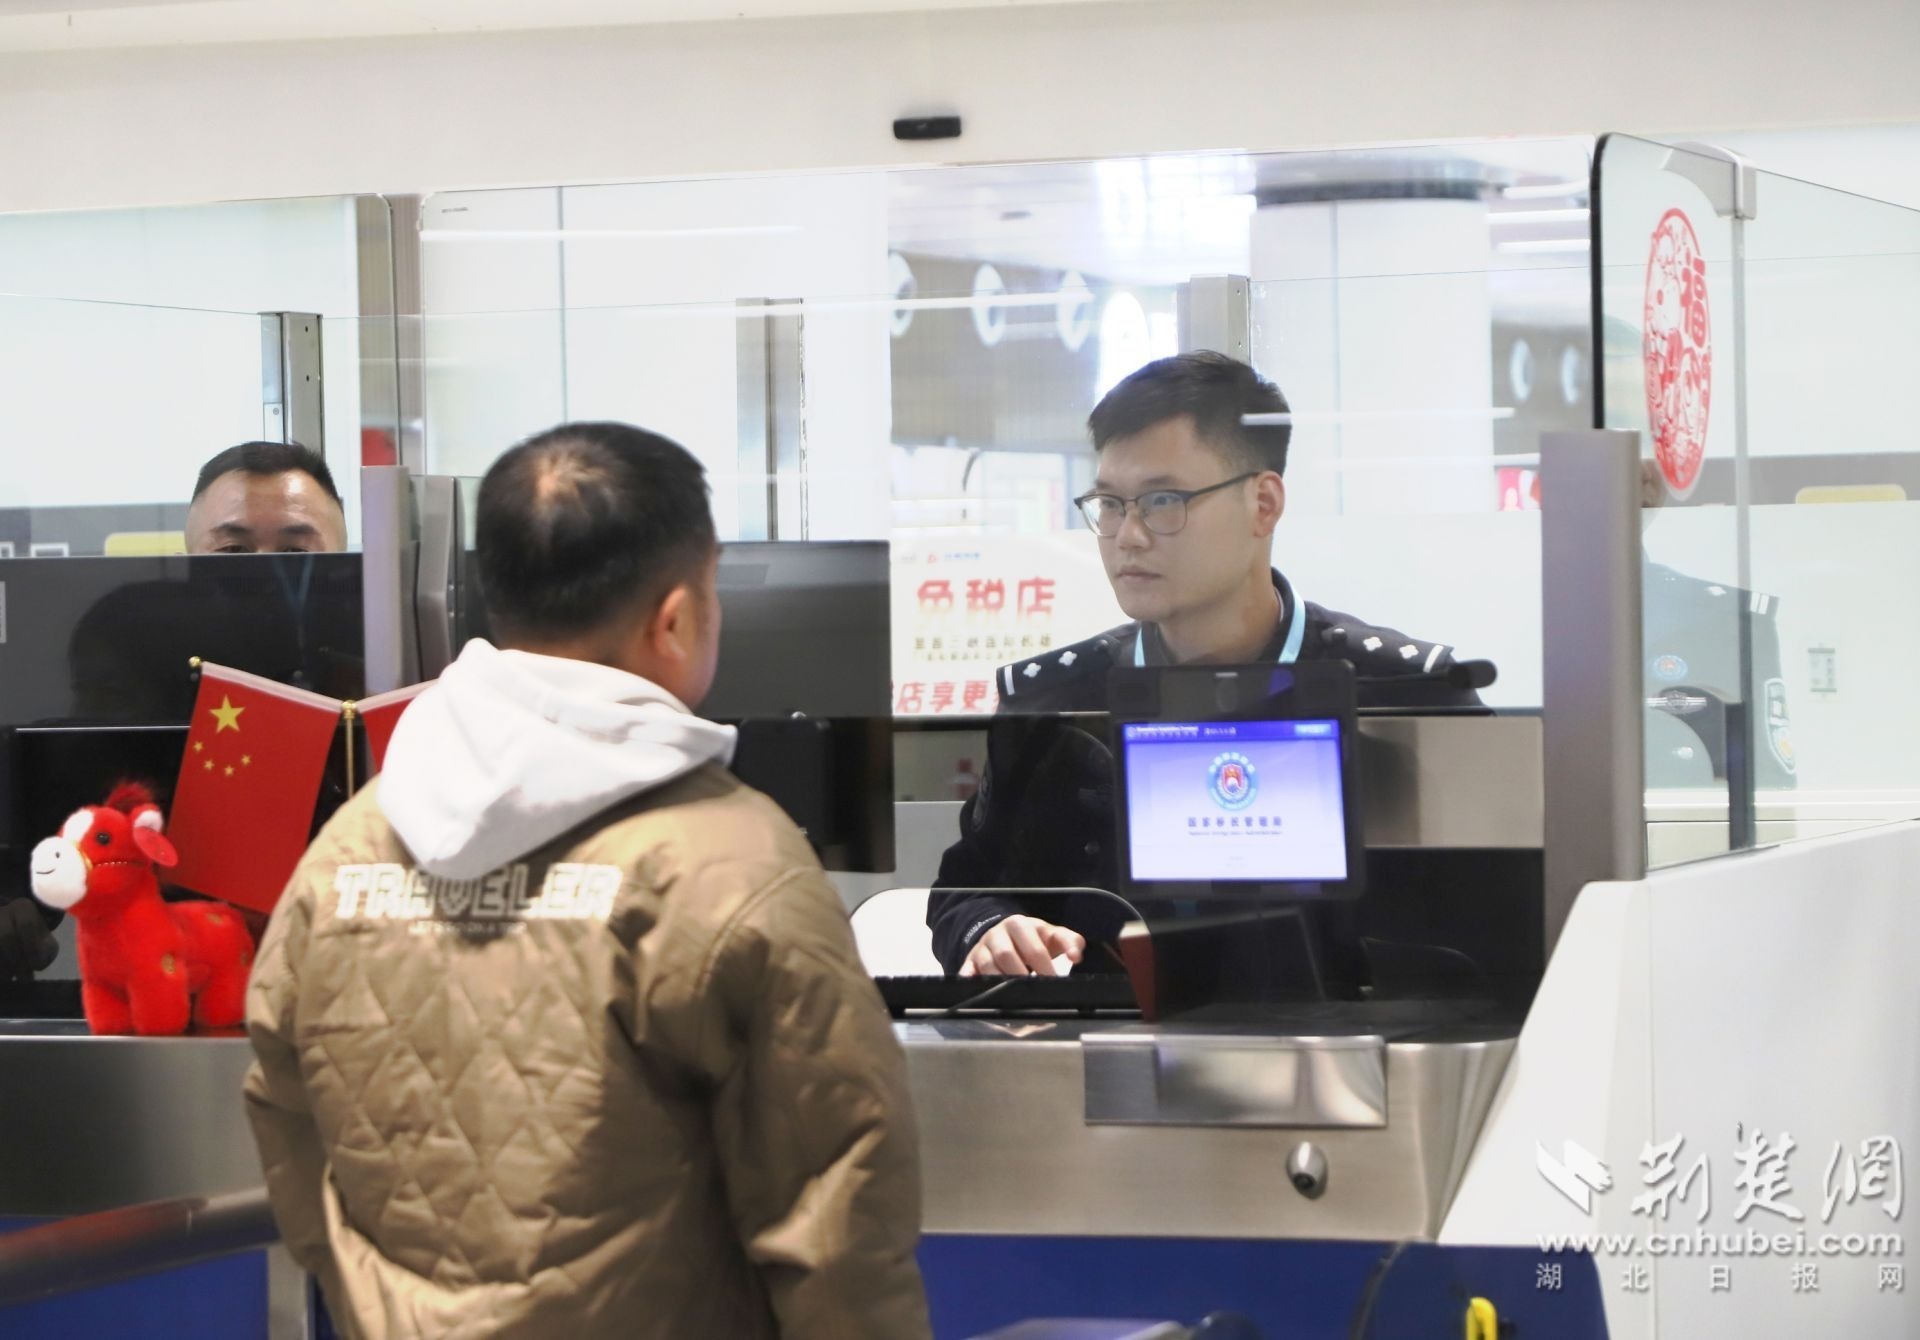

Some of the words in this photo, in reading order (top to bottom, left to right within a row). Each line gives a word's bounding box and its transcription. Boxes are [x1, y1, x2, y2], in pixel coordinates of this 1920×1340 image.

[894, 680, 999, 713] 店享更
[334, 863, 623, 919] TRAVELER
